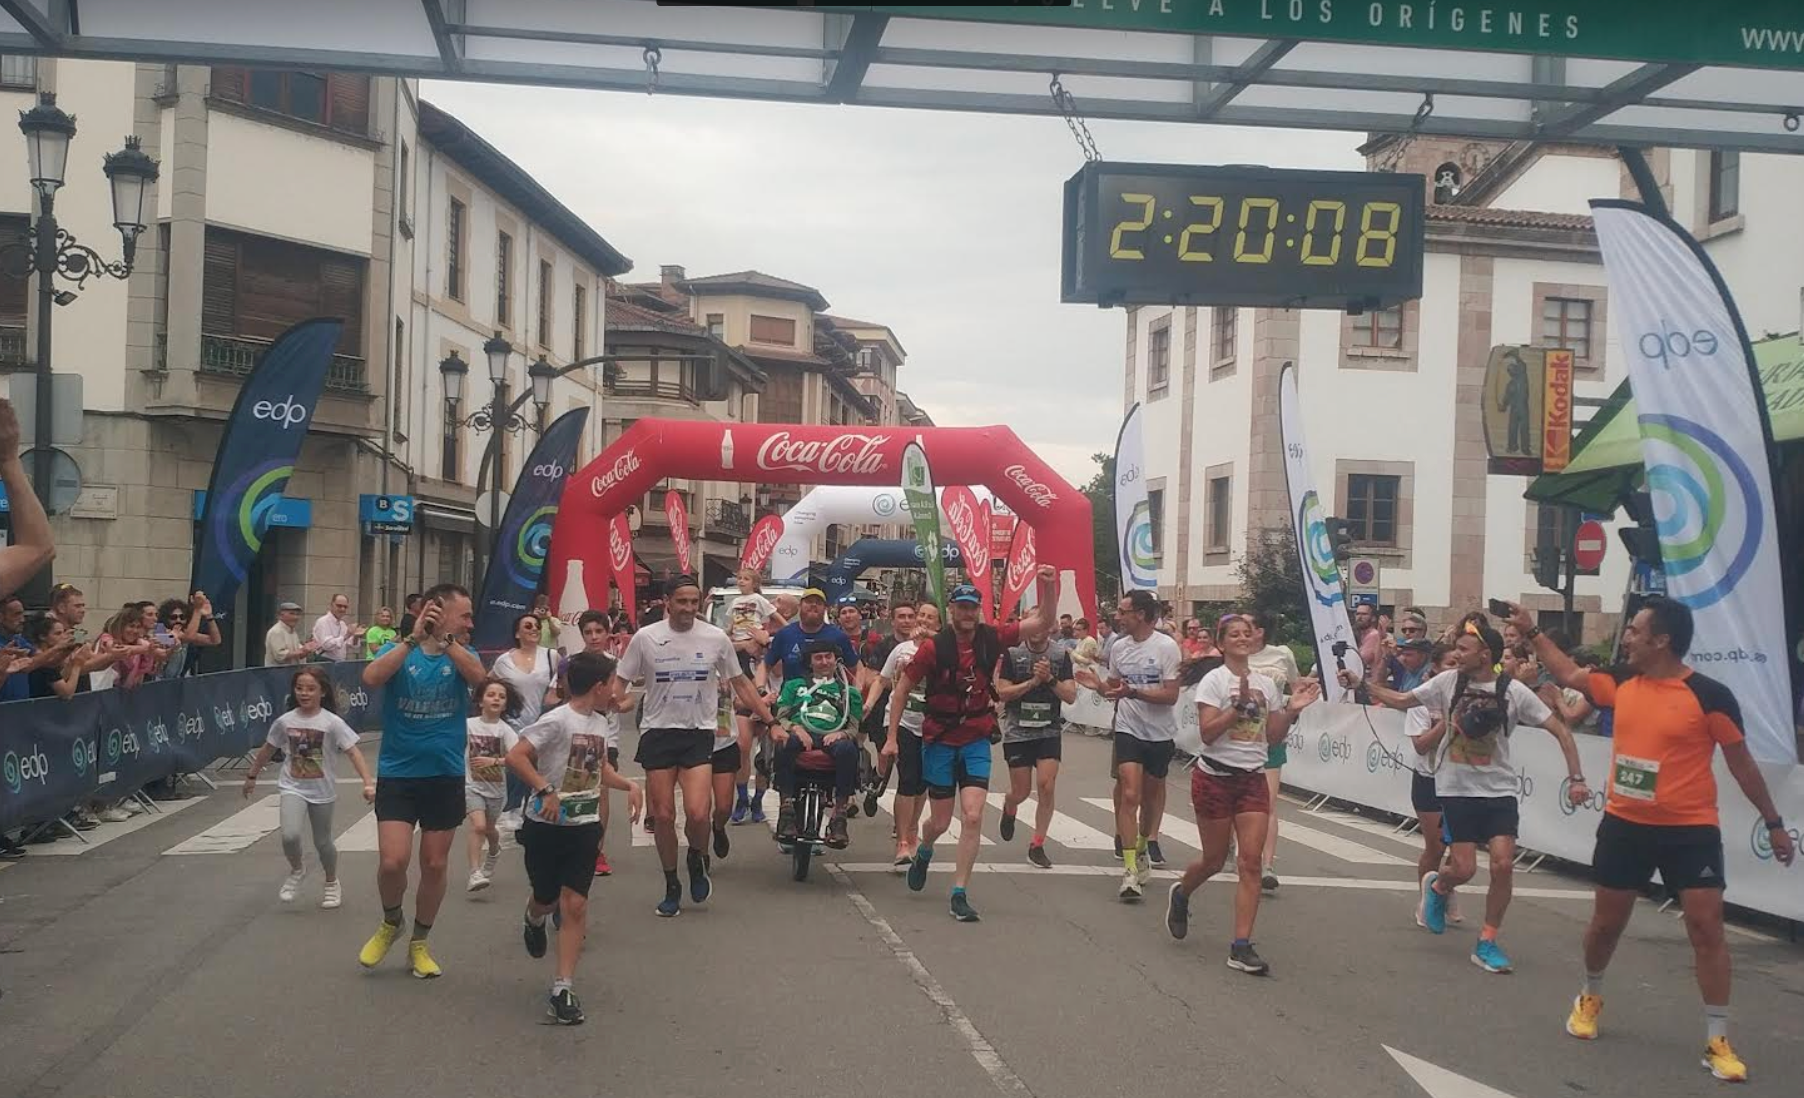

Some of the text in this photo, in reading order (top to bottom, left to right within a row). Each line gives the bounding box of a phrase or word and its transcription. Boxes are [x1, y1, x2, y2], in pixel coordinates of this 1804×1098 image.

[1208, 0, 1224, 17] A
[1261, 0, 1333, 23] LOS
[1369, 0, 1579, 40] ORÍGENES
[1109, 192, 1402, 268] 2:20:08
[1547, 353, 1570, 427] Kodak
[252, 394, 306, 430] edp
[756, 431, 892, 474] Coca-Cola
[532, 458, 564, 483] edp
[591, 446, 642, 498] Coca-Cola
[1004, 464, 1060, 509] Coca-Cola
[391, 499, 411, 522] S
[941, 543, 960, 562] dp
[247, 695, 273, 723] edp
[349, 686, 368, 710] edp
[20, 743, 49, 785] edp
[1331, 734, 1352, 764] edp
[1380, 743, 1404, 776] edp
[1619, 769, 1645, 786] 247
